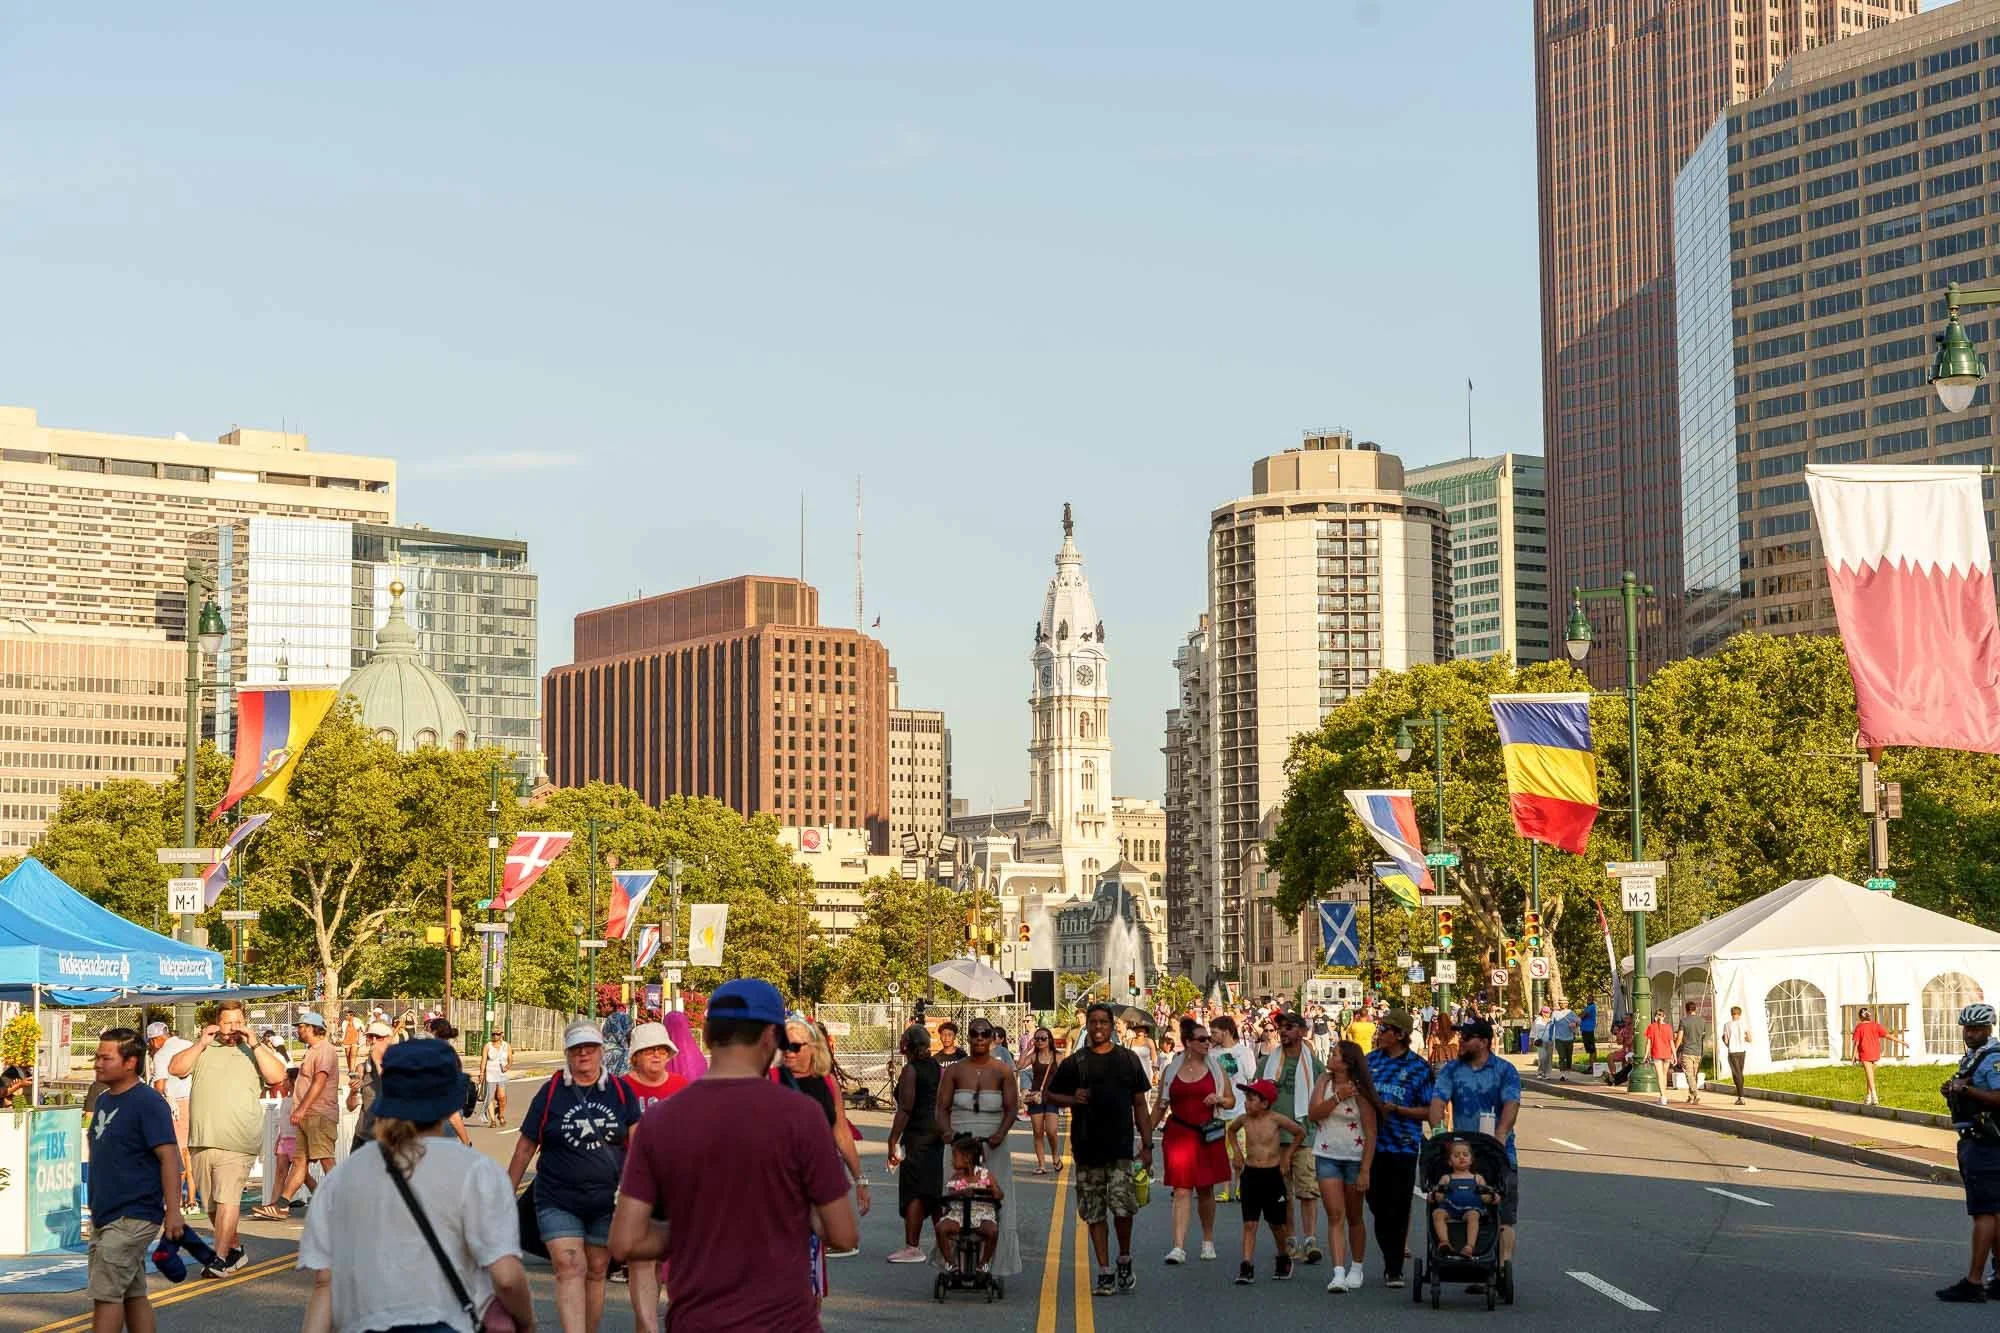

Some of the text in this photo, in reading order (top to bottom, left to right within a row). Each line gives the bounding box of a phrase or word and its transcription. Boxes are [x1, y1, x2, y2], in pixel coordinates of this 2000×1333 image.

[175, 894, 196, 911] M-1
[1628, 892, 1651, 907] M-2
[58, 952, 121, 981] Independence
[159, 954, 206, 981] Independence
[1441, 963, 1452, 971] NO
[46, 1130, 67, 1161] IBX
[35, 1160, 75, 1194] OASIS
